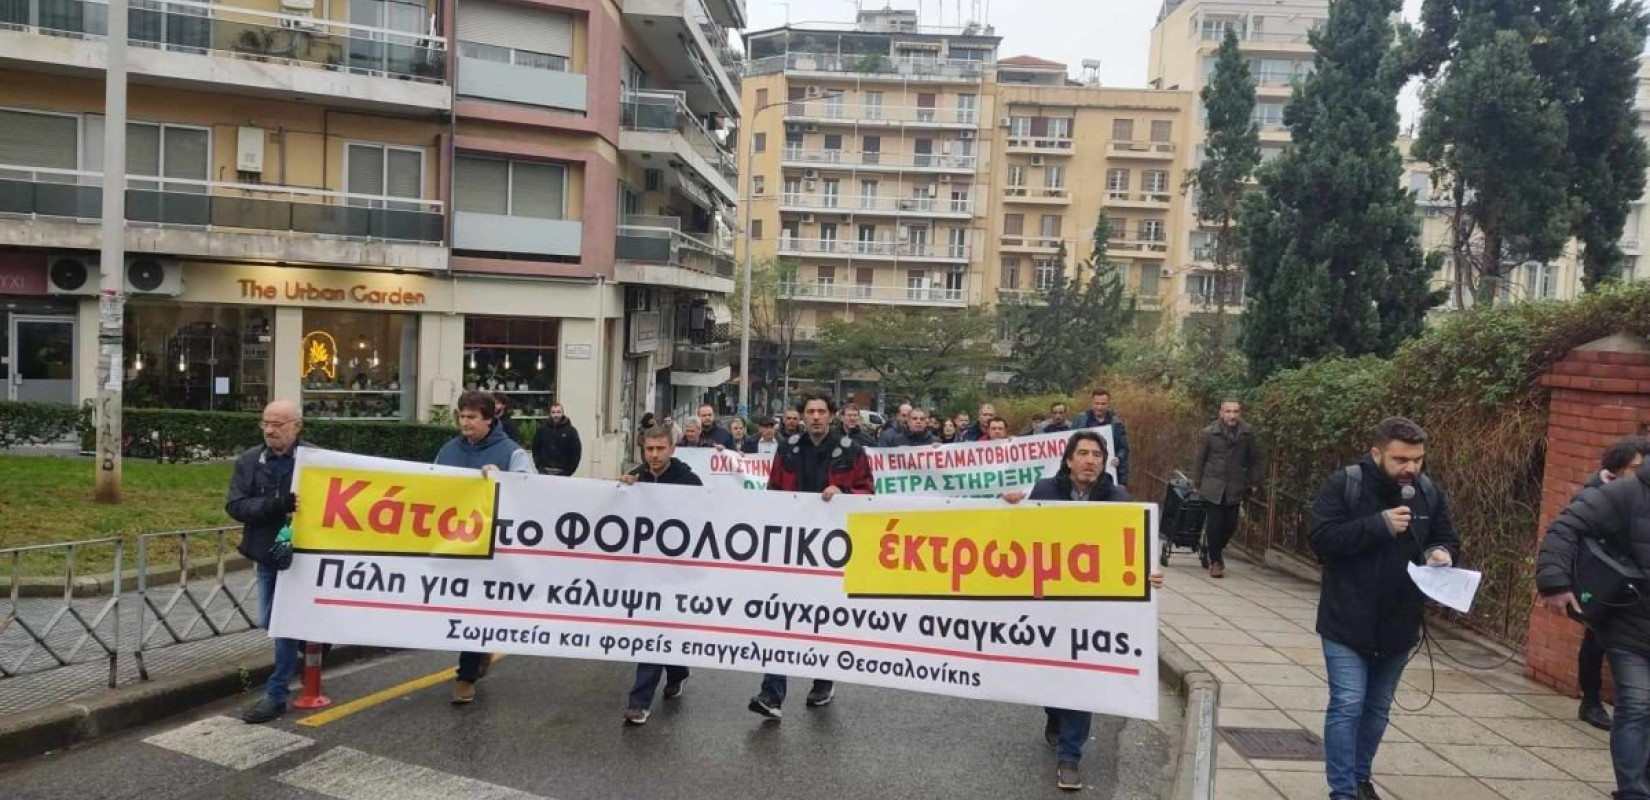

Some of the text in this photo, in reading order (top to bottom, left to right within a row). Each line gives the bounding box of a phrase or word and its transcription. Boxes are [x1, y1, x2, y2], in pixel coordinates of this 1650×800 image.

[237, 279, 426, 305] The Urban Garden
[710, 454, 734, 473] ΟΧΙ
[942, 465, 1045, 490] ΣΤΗΡΙΞΗΣ
[322, 477, 1137, 599] Κάτω το ΦΟΡΟΛΟΓΙΚΟ έκτρωμα !
[316, 558, 1143, 660] Πάλη για την κάλυψη των σύγχρονων αναγκών μας.
[446, 619, 981, 687] Σωματεία και φορείς επαγγελματιών Θεσσαλονίκης
